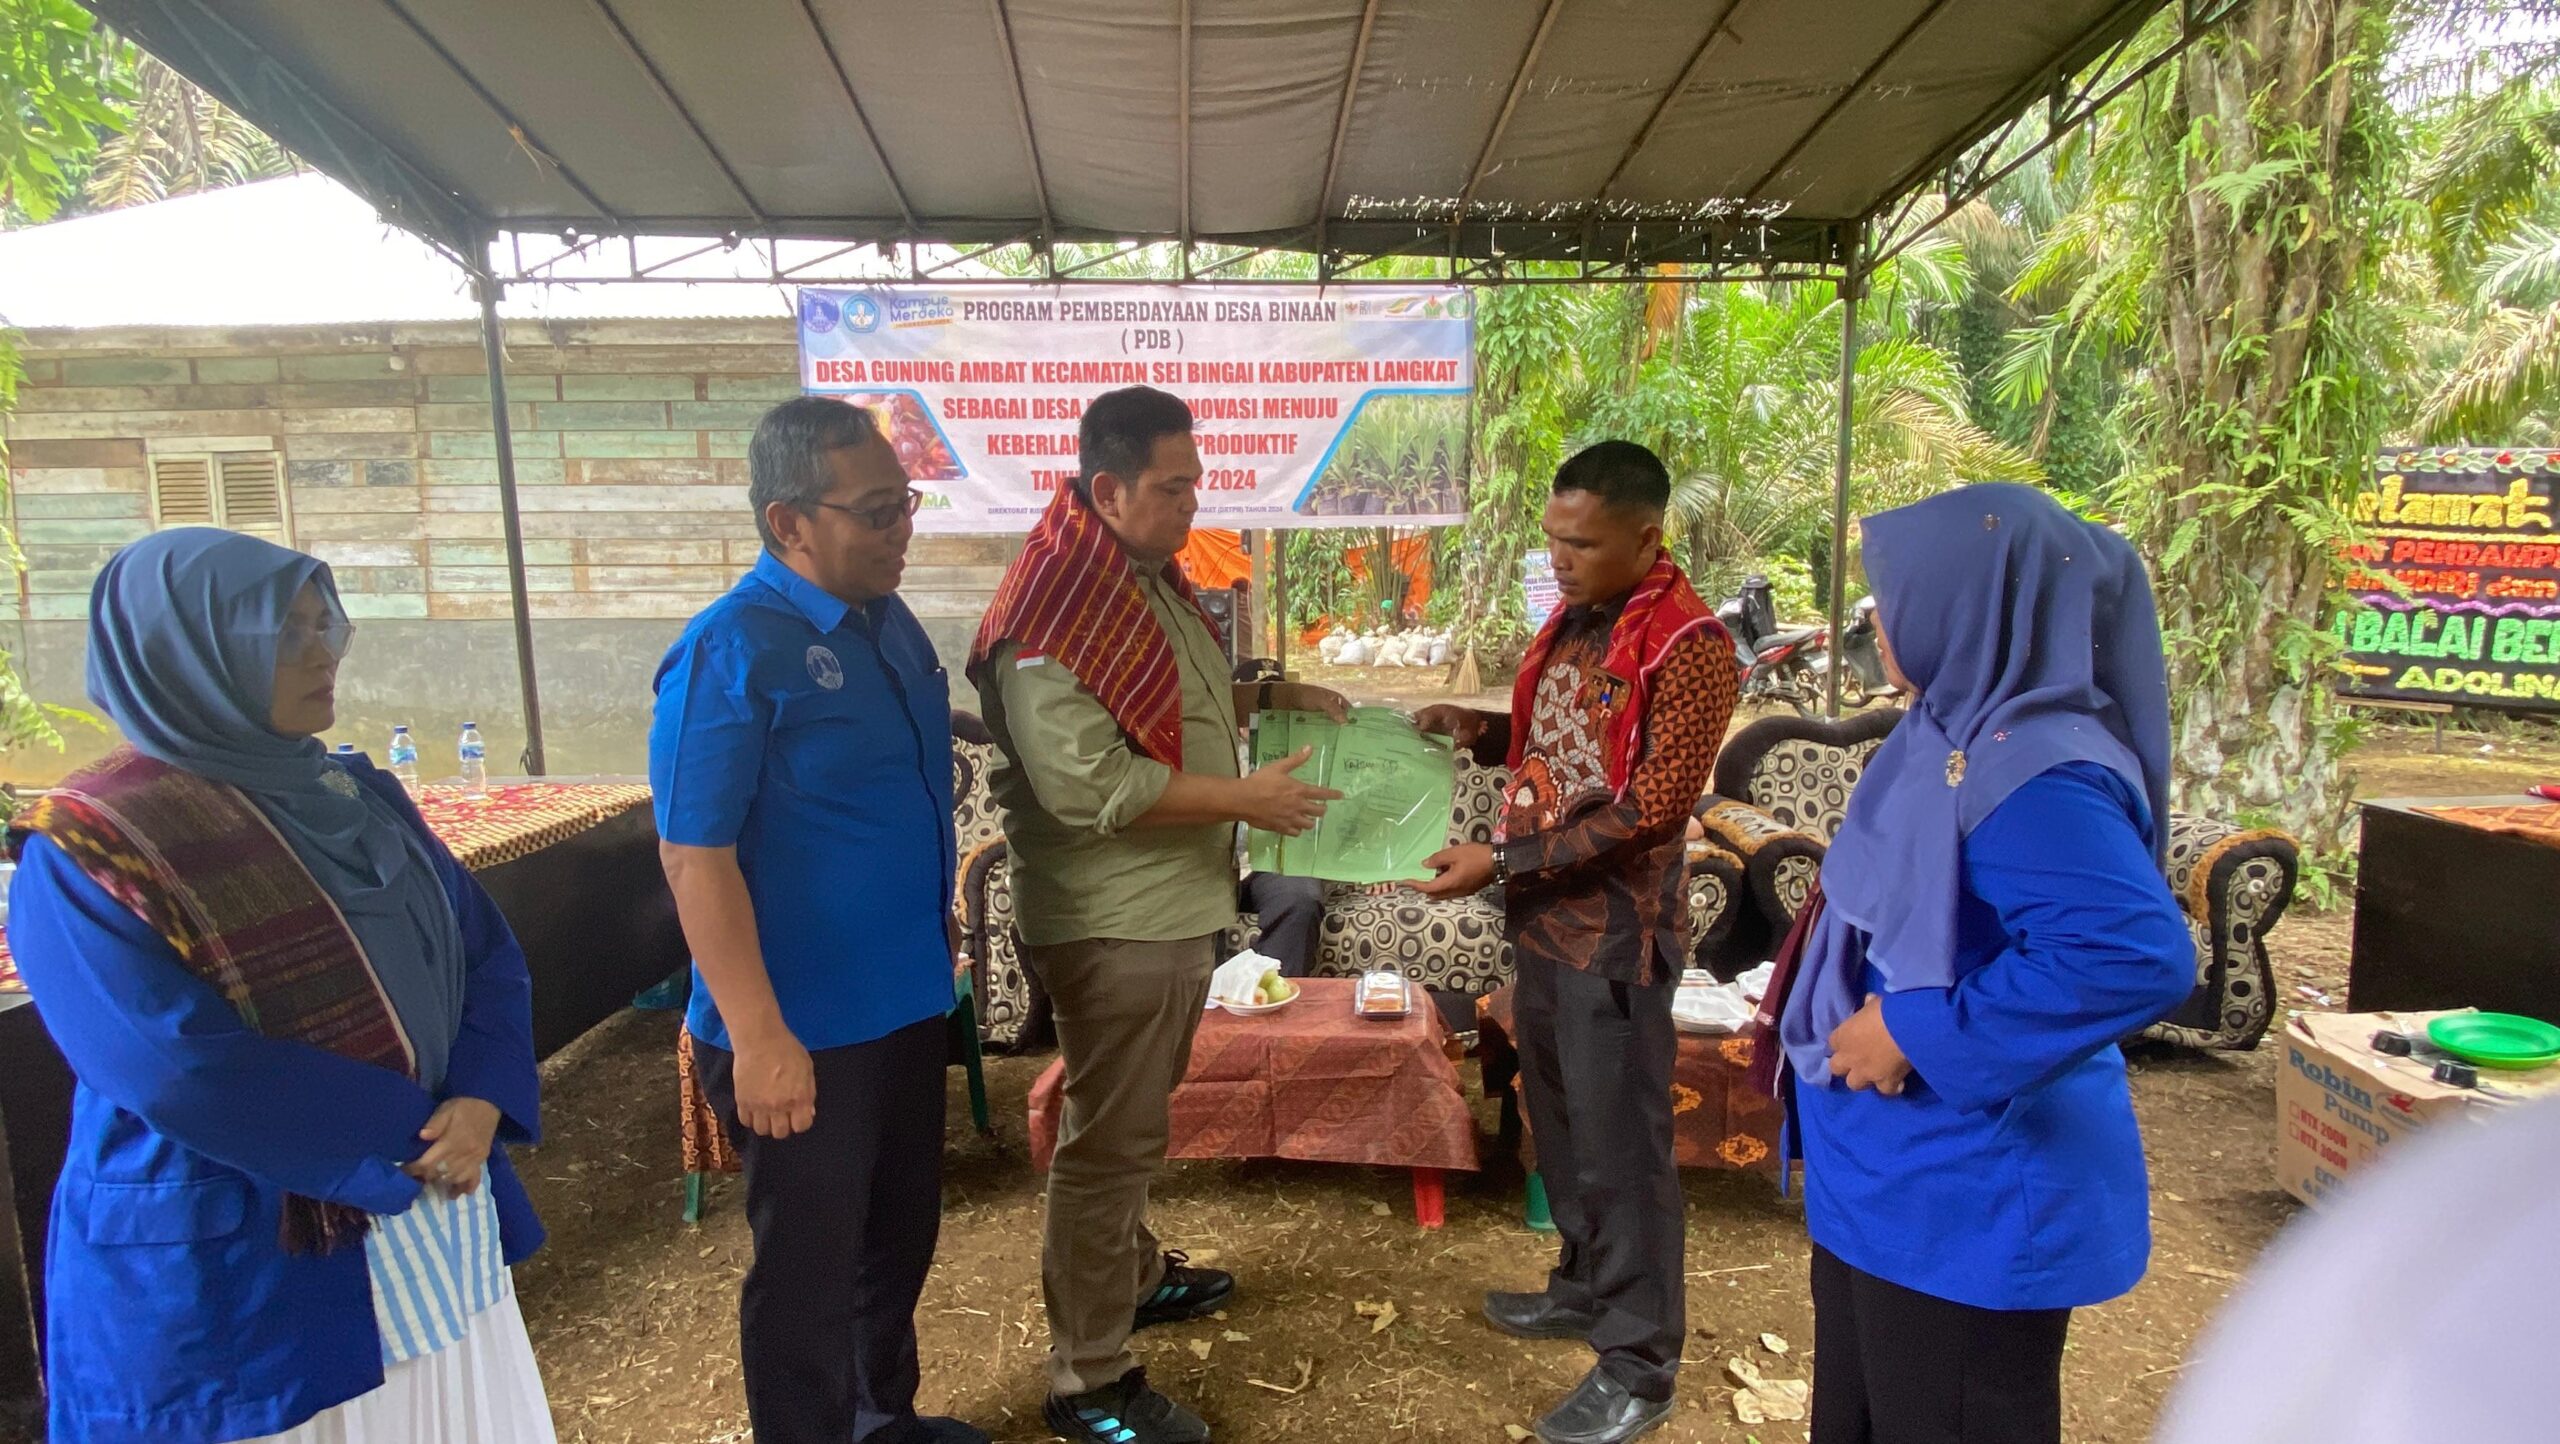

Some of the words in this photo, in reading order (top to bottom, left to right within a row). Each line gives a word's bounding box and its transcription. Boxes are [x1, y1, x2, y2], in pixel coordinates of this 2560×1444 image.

[890, 296, 949, 310] Kampus
[963, 301, 1053, 321] PROGRAM
[1060, 301, 1208, 322] PEMBERDAYAAN
[1215, 301, 1263, 322] DESA
[1269, 301, 1336, 322] BINAAN
[890, 306, 954, 322] Merdeka
[1134, 329, 1171, 350] PDB
[816, 361, 867, 383] DESA
[872, 361, 955, 383] GUNUNG
[959, 361, 1027, 383] AMBAT
[1032, 361, 1147, 383] KECAMATAN
[1152, 361, 1182, 383] SEI
[1187, 361, 1254, 383] BINGAI
[1259, 361, 1369, 383] KABUPATEN
[1374, 361, 1458, 382] LANGKAT
[943, 398, 1027, 419] SEBAGAI
[1032, 398, 1082, 419] DESA
[1184, 398, 1258, 419] NOVASI
[1263, 398, 1338, 419] MENUJU
[987, 434, 1080, 455] KEBERLAN
[1208, 469, 1257, 490] 2024
[2352, 611, 2487, 660] BALAI
[2289, 1046, 2373, 1111] Robin
[2324, 1092, 2389, 1147] Pump
